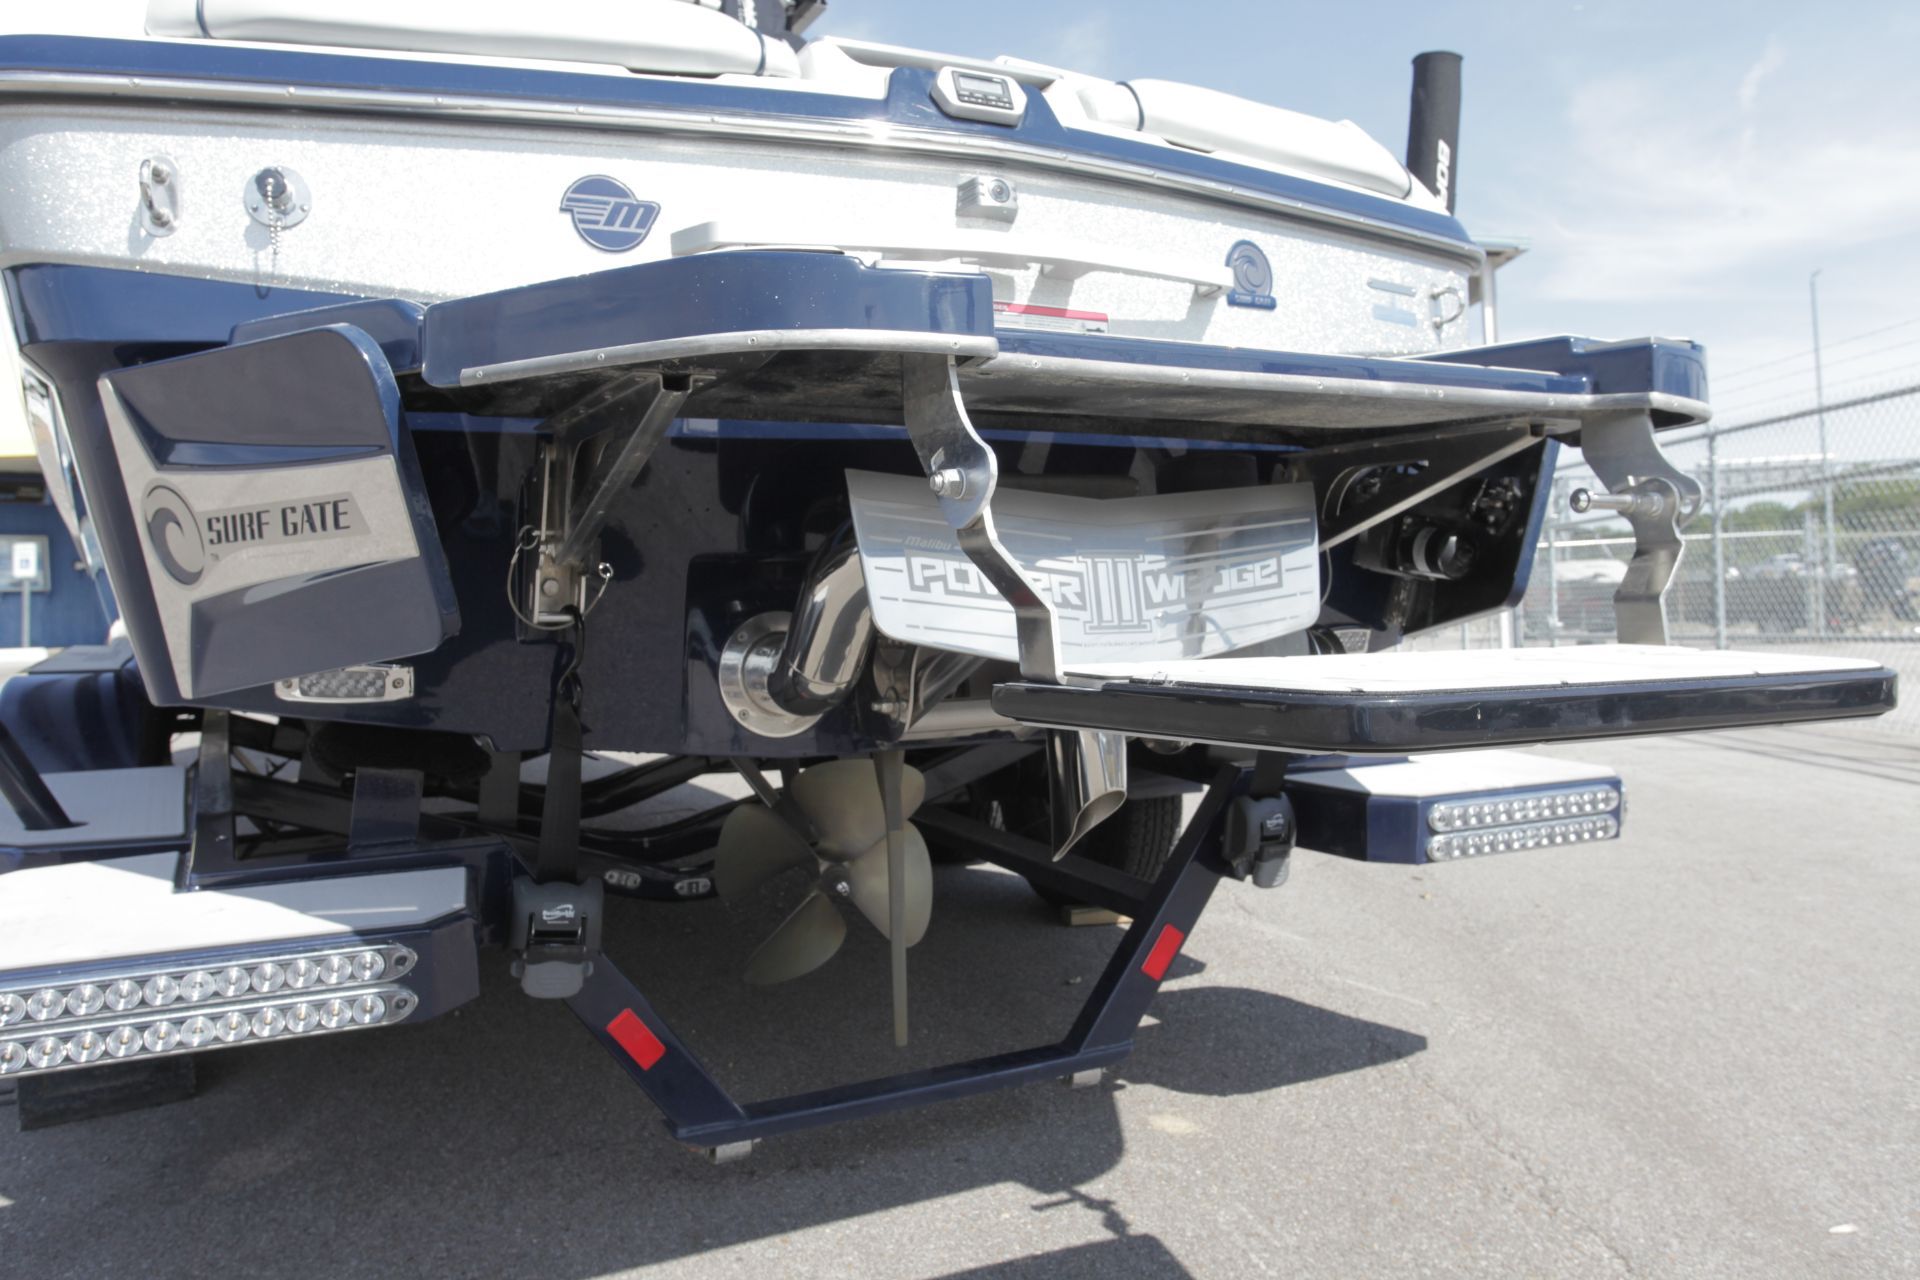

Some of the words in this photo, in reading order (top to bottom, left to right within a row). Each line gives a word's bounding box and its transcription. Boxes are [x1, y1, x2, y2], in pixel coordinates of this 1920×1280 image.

[207, 510, 271, 546] SURF
[281, 498, 351, 537] GATE
[904, 535, 953, 551] Malibu
